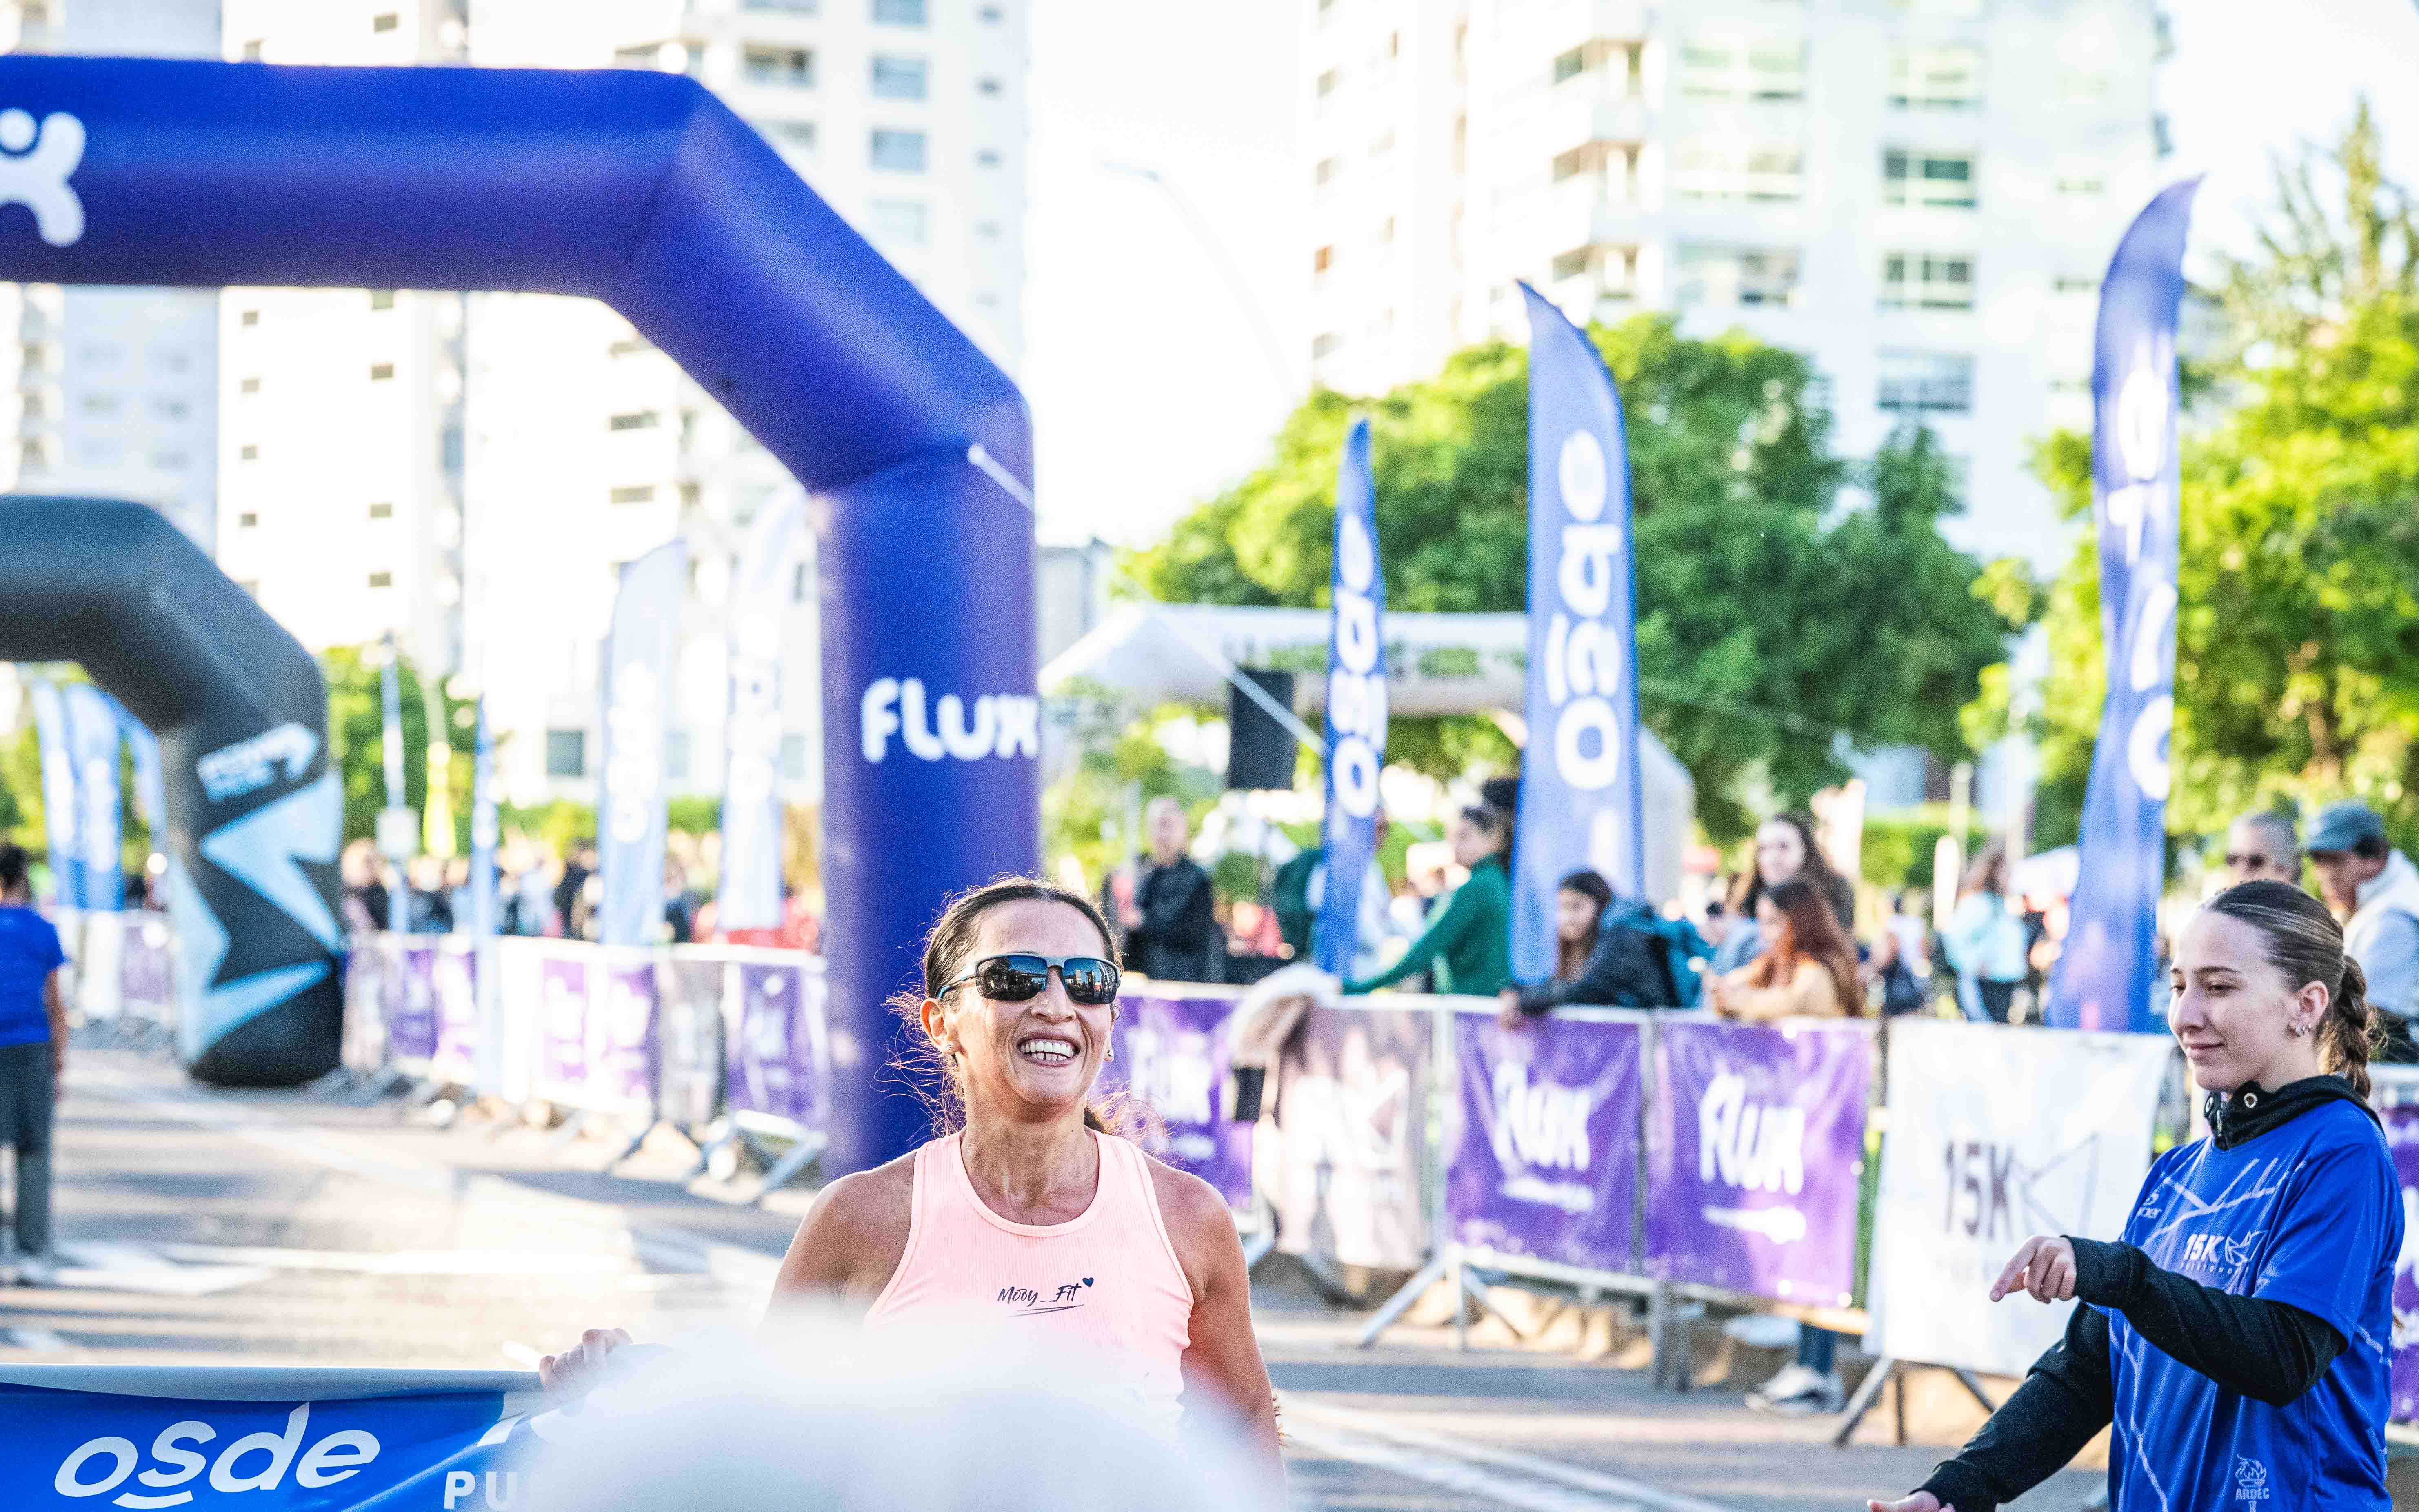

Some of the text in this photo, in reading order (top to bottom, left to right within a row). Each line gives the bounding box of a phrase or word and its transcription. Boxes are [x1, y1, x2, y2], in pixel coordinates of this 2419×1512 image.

[1943, 1142, 2014, 1243] 15K
[2183, 1233, 2225, 1263] 15K
[53, 1401, 380, 1509] osde
[2235, 1487, 2270, 1500] ARDEC
